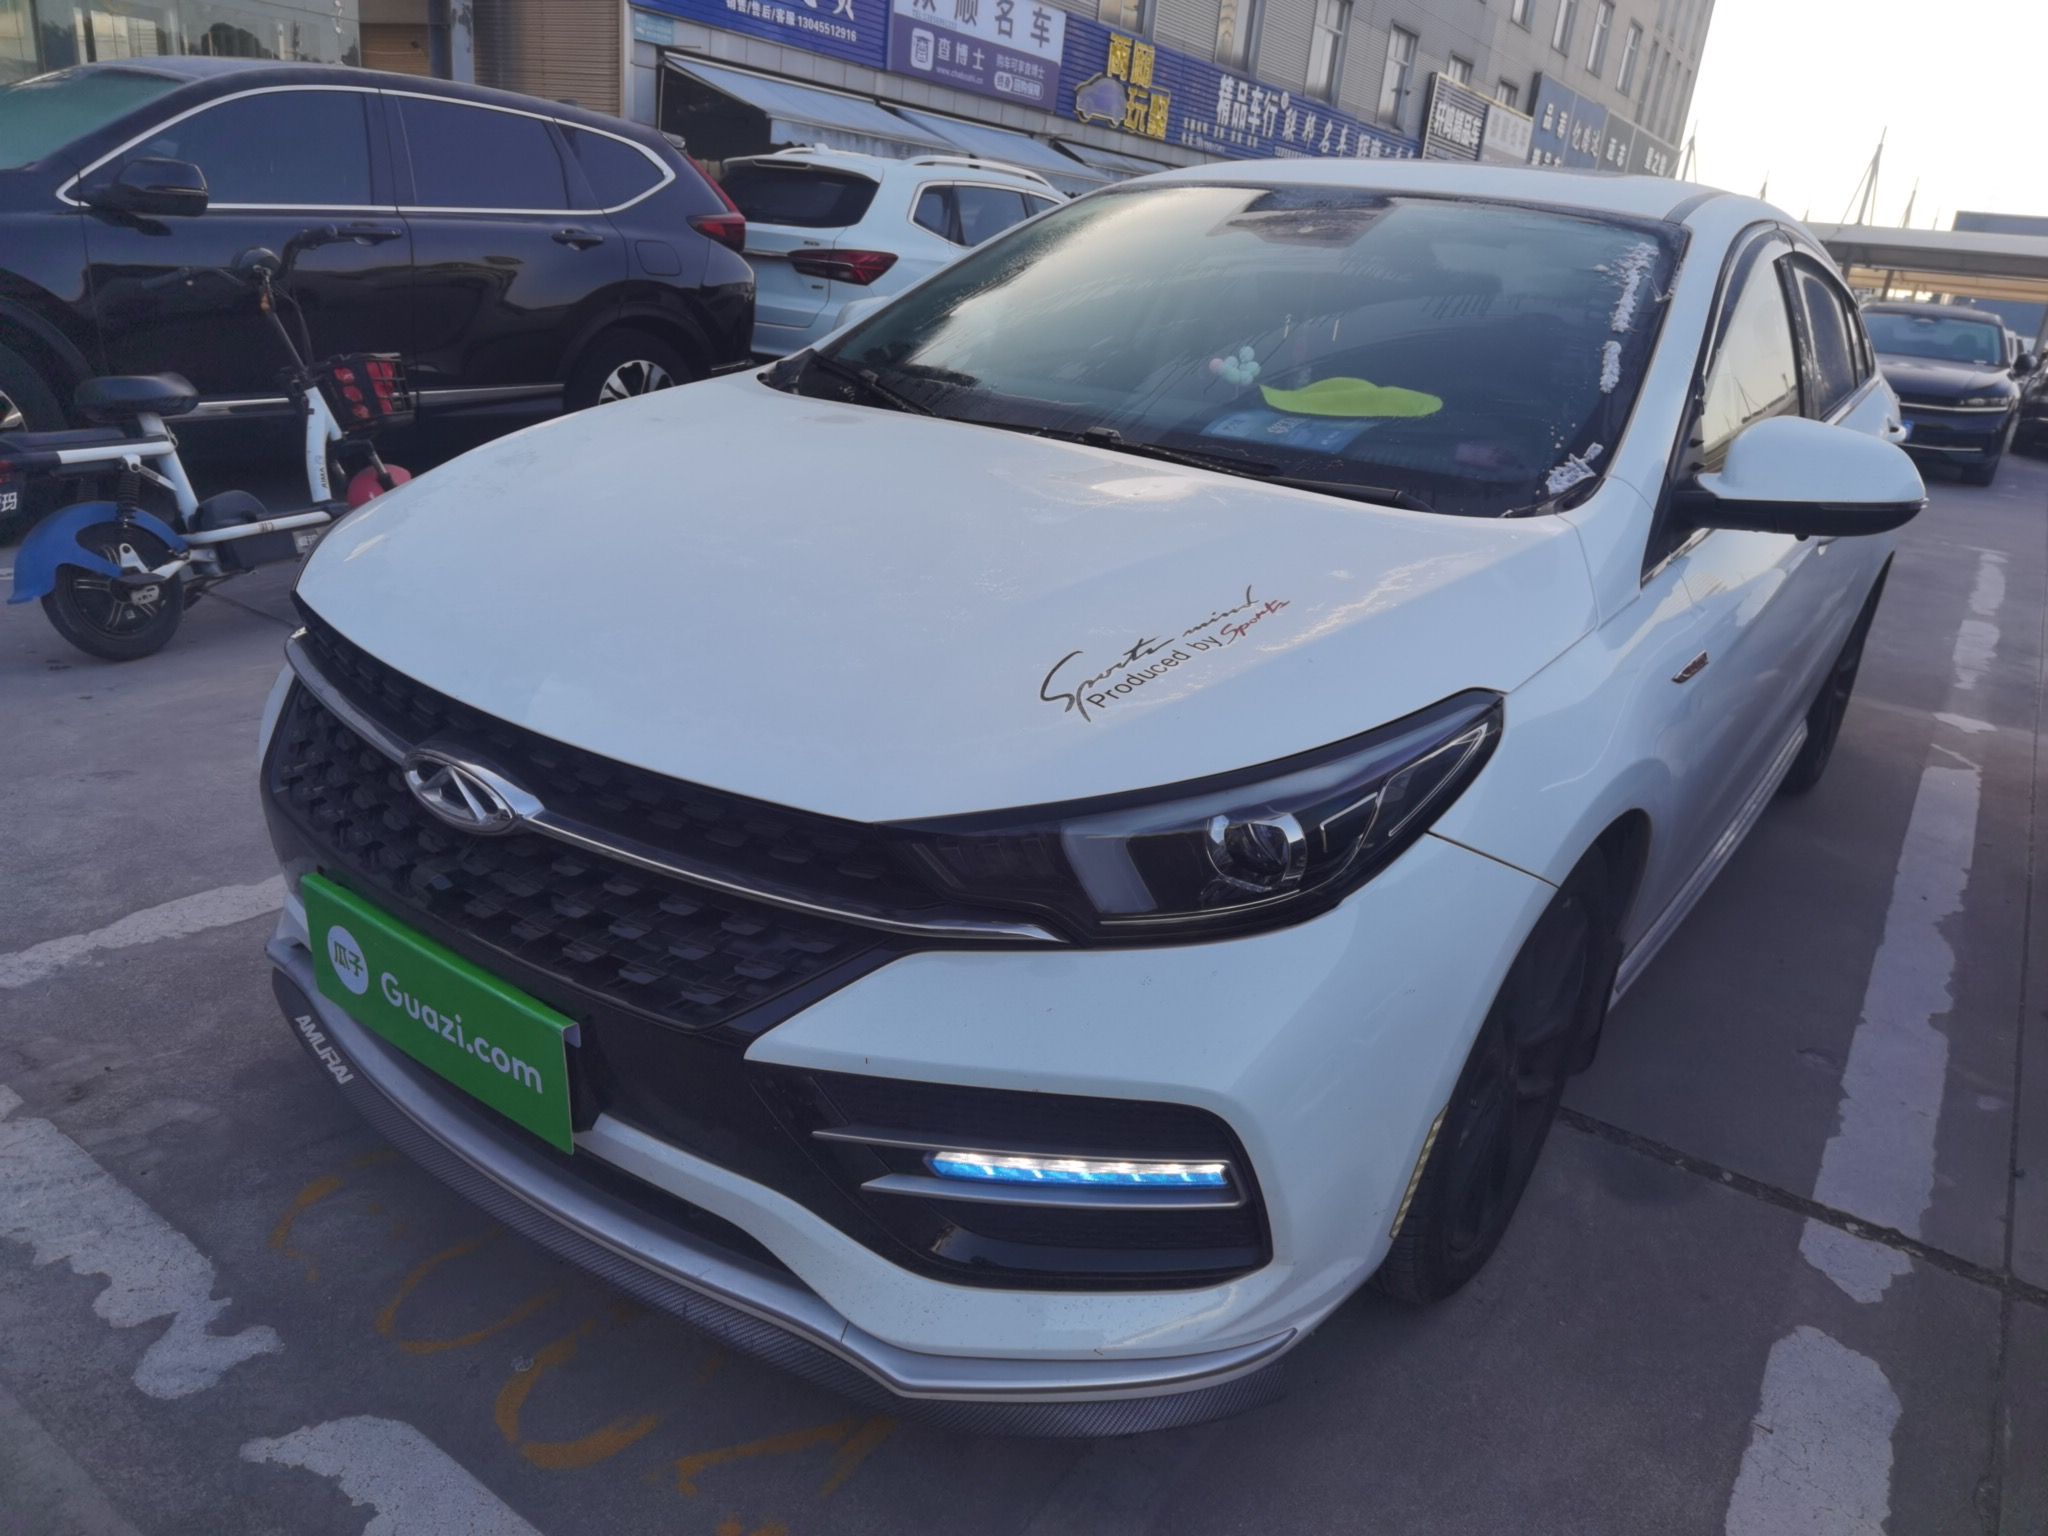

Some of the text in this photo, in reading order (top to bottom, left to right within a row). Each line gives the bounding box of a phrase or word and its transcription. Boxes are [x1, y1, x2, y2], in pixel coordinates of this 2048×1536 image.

[798, 15, 857, 41] 13045512916
[912, 0, 1051, 48] 顺名车
[938, 38, 985, 71] 查博士
[1216, 73, 1280, 139] 精品车行
[1086, 599, 1290, 708] Produced by Sports
[334, 940, 363, 977] 瓜子
[381, 972, 543, 1094] Guazi.com
